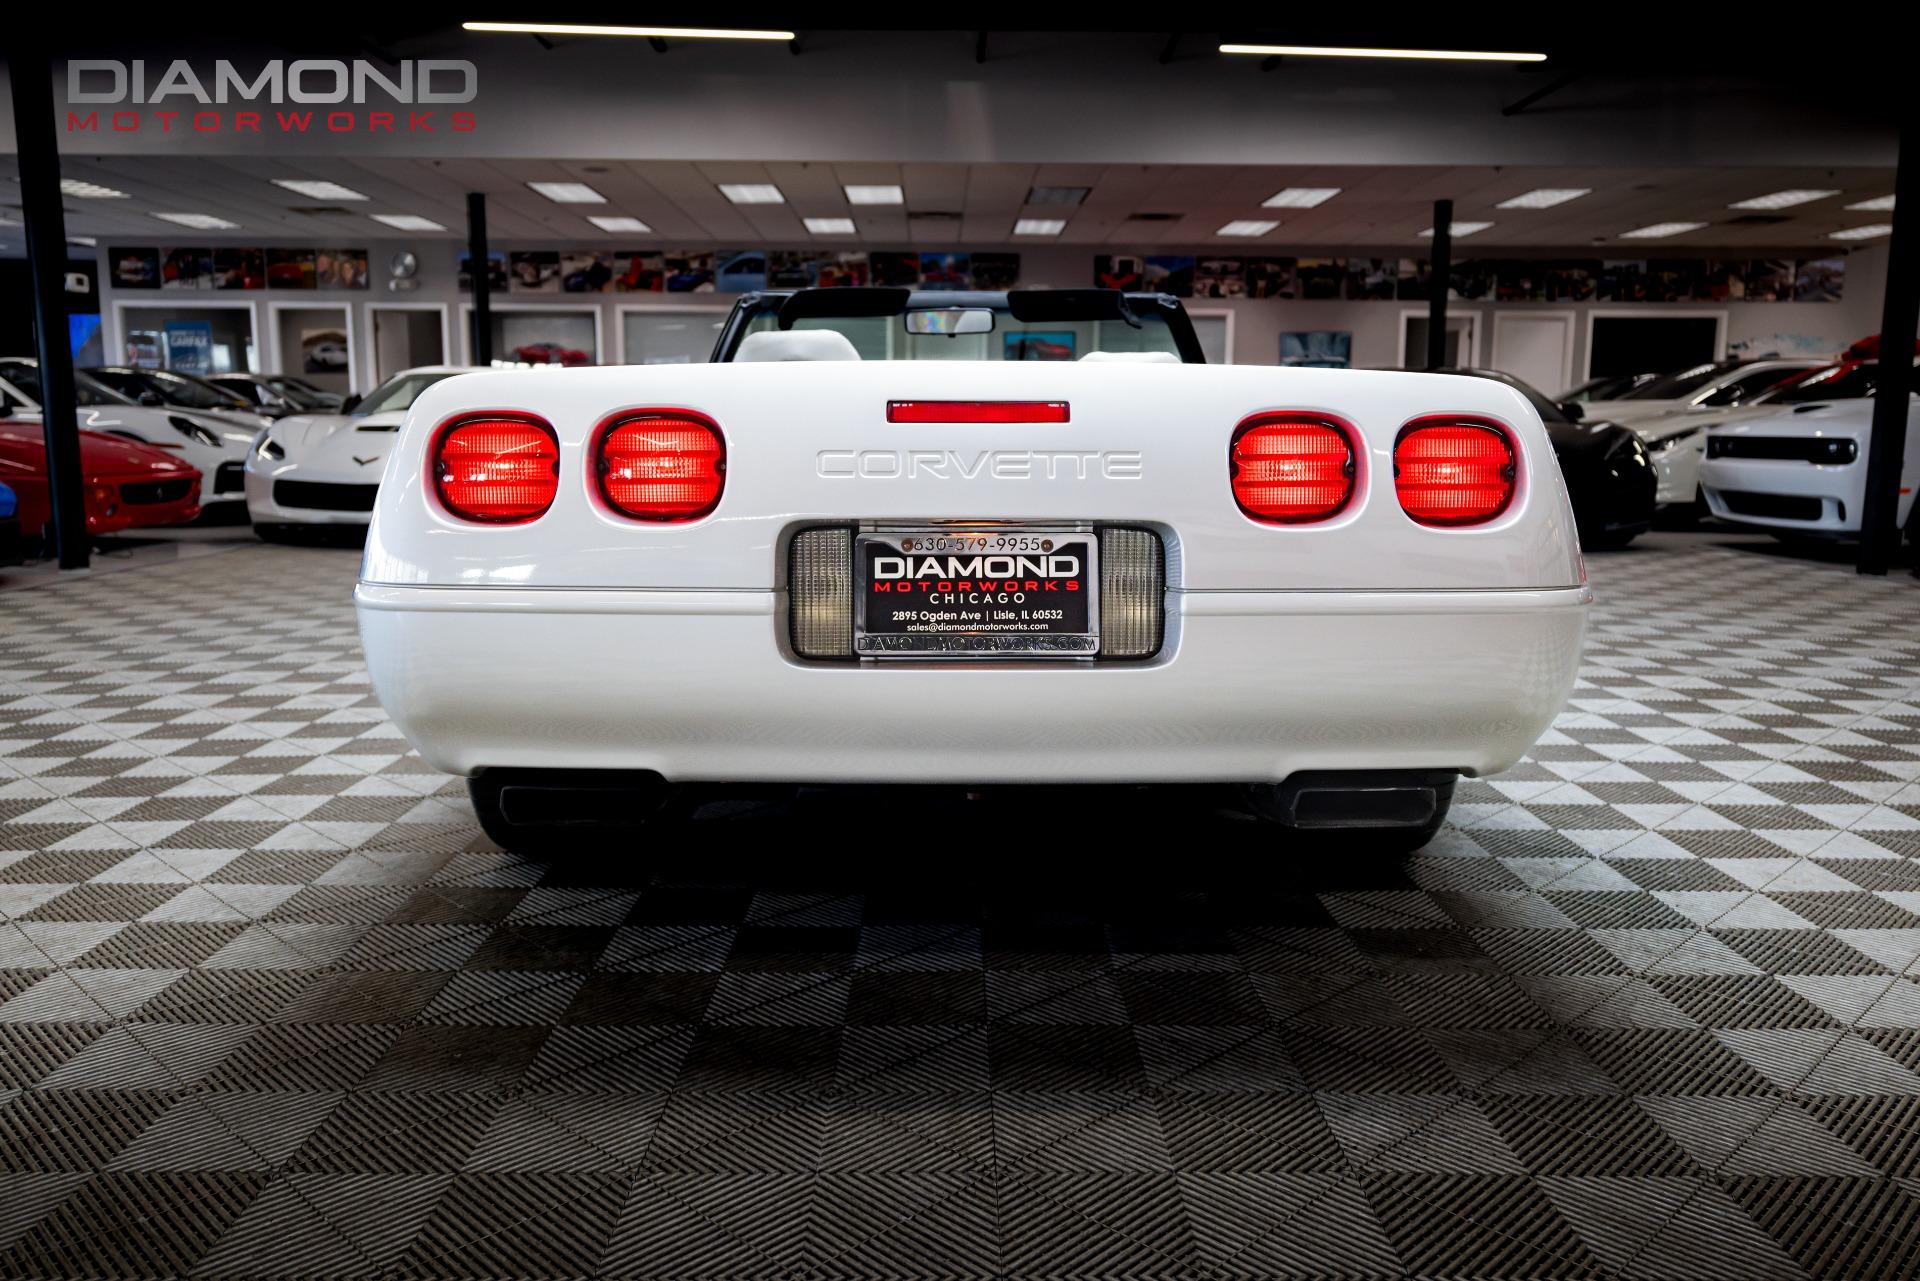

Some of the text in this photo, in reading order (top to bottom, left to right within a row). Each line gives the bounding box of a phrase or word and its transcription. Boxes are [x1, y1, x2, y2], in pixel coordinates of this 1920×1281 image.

[816, 450, 1142, 479] CORVETTE
[913, 537, 1041, 552] 630-579-9955
[874, 556, 1080, 579] DIAMOND
[874, 581, 1080, 592] MOTORWORKS
[929, 593, 1025, 604] CHICAGO
[892, 611, 917, 621] 2895
[920, 611, 957, 622] Ogden
[960, 611, 982, 620] Ave
[993, 611, 1019, 621] Lisle,
[1021, 610, 1030, 620] IL
[1032, 610, 1063, 620] 60532
[907, 622, 1049, 632] sales@diamondmotorworks.com
